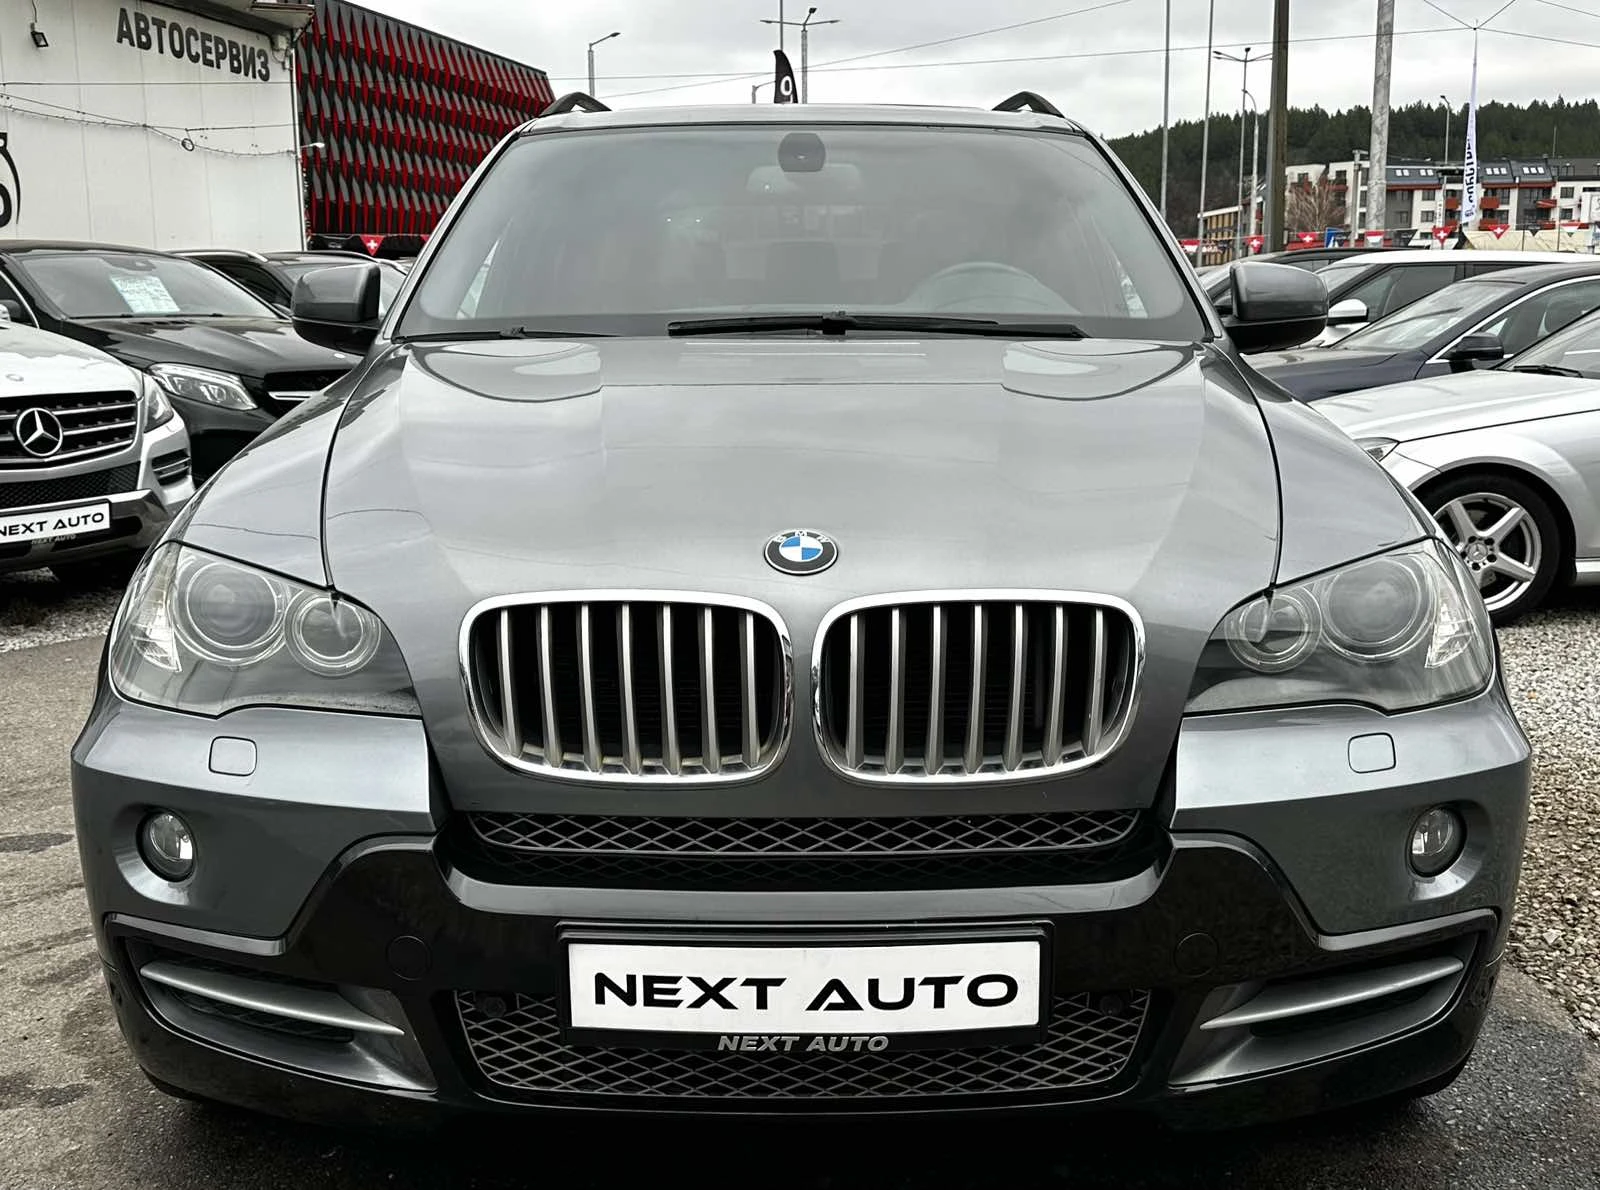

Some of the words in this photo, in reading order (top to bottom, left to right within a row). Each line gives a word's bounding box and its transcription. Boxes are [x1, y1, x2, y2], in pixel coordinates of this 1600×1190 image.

[117, 8, 270, 82] АВТОСЕРВИЗ
[53, 512, 104, 530] AUTO
[594, 972, 787, 1010] NEXT
[805, 973, 1018, 1011] AUTO
[718, 1035, 799, 1052] NEXT
[806, 1035, 889, 1052] AUTO
